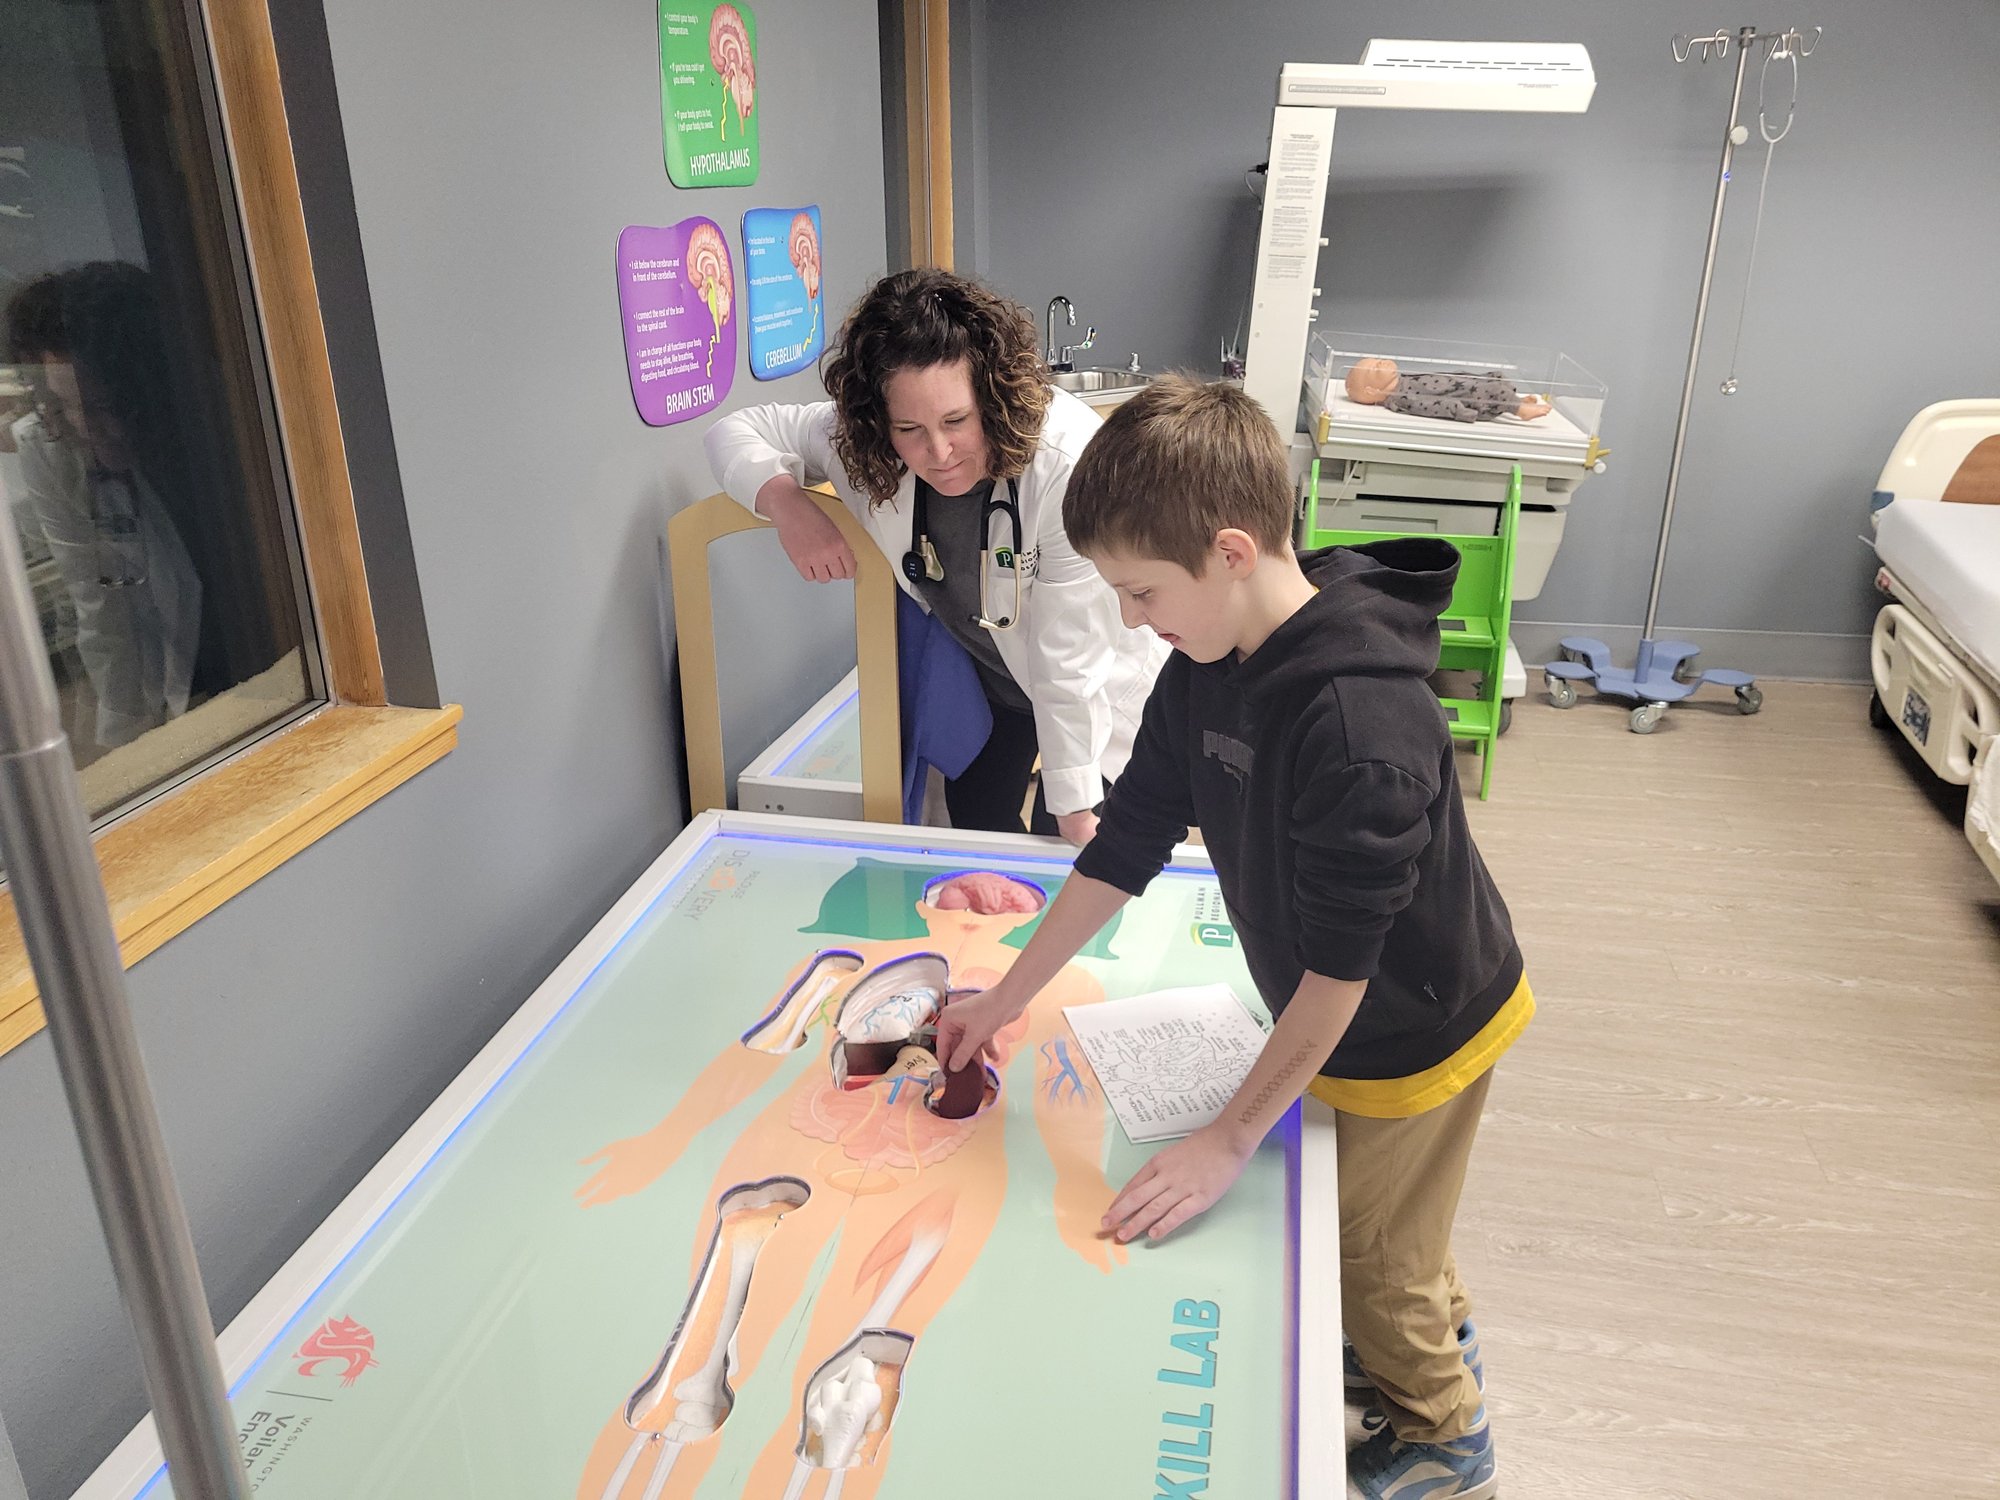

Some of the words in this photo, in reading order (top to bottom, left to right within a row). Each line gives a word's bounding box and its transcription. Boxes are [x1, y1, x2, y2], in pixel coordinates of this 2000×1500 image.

[690, 148, 751, 177] HYPOTHALAMUS
[638, 259, 649, 269] below
[765, 343, 803, 369] CEREBELLUM
[666, 389, 692, 415] BRAIN
[692, 383, 715, 407] STEM
[1001, 552, 1011, 567] P
[1194, 887, 1206, 920] PULLMAN
[1201, 927, 1232, 942] P
[1156, 1298, 1221, 1389] LAB
[245, 1413, 296, 1469] Voilan
[251, 1416, 313, 1491] WASHINGTO
[1153, 1402, 1214, 1500] KILL
